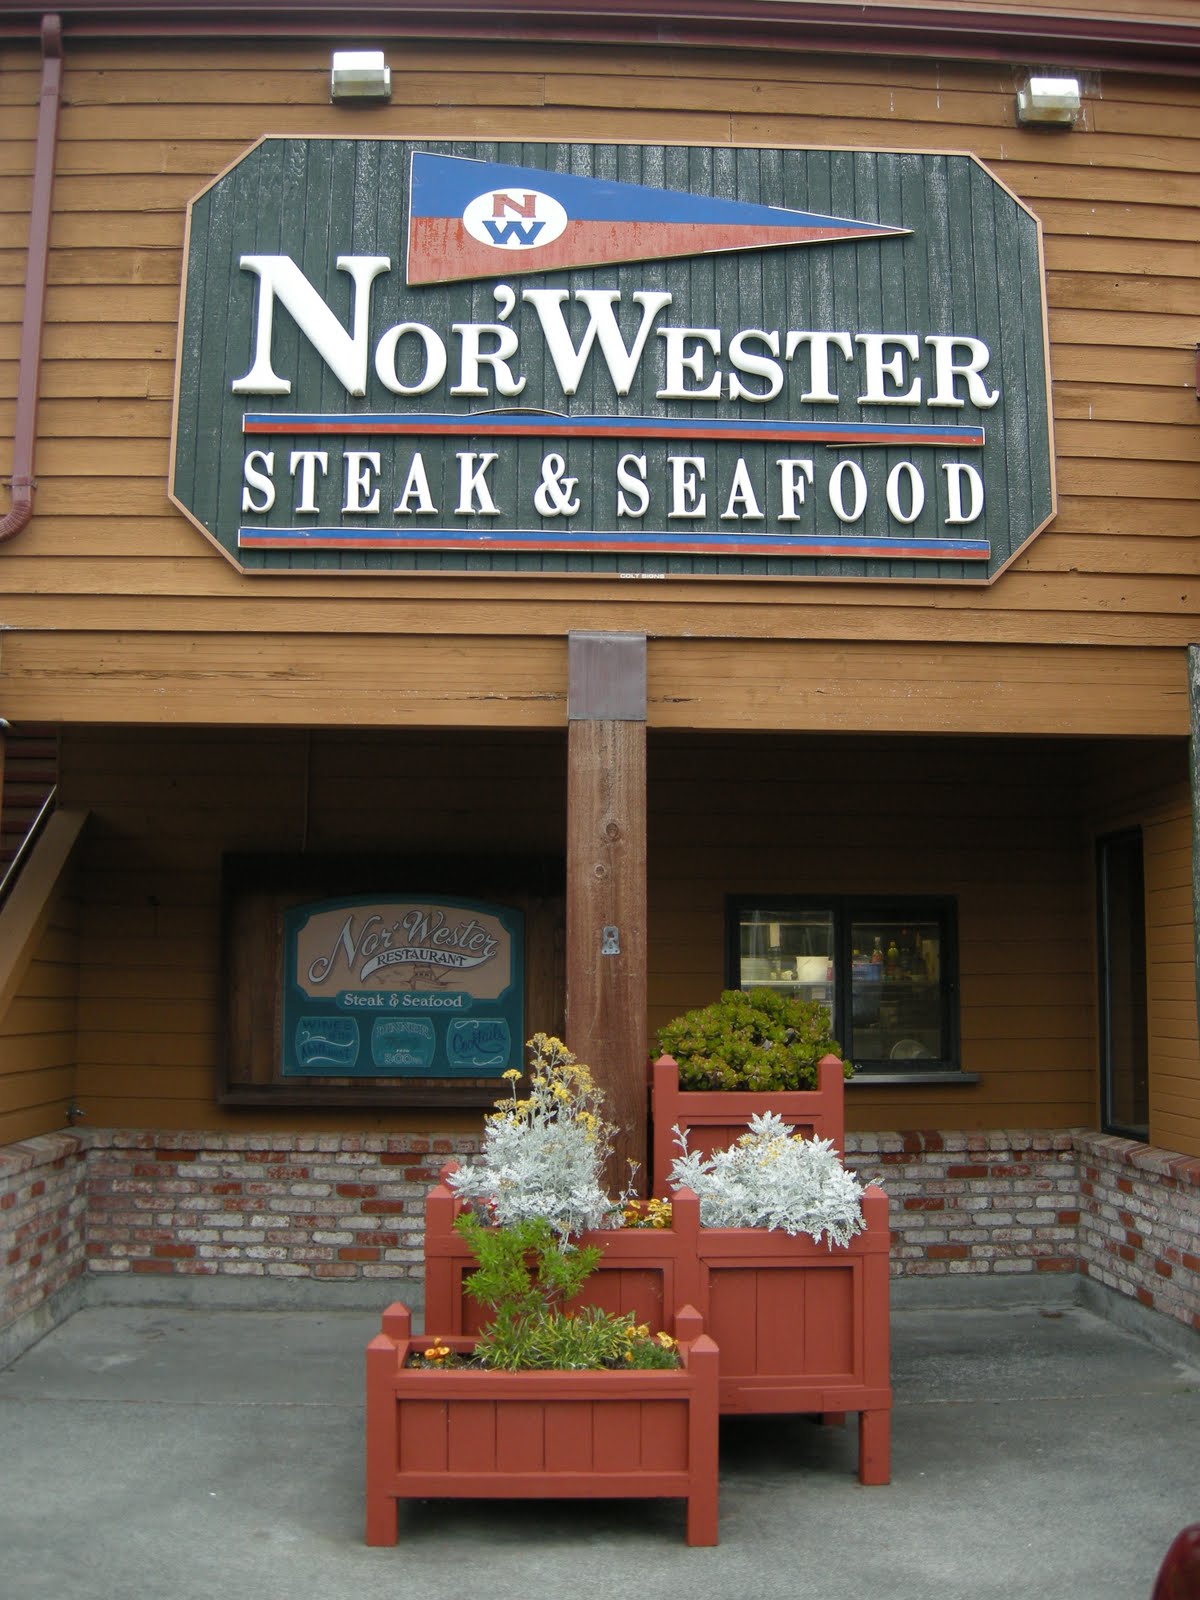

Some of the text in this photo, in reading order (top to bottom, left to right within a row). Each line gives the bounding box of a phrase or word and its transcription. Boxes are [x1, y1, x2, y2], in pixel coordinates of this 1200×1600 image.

[492, 193, 537, 218] N
[482, 220, 546, 245] W
[242, 450, 984, 525] STEAK & SEAFOOD
[376, 948, 468, 968] RESTAURANT
[343, 993, 463, 1009] Steak & Seafood
[375, 1021, 432, 1040] DINNER
